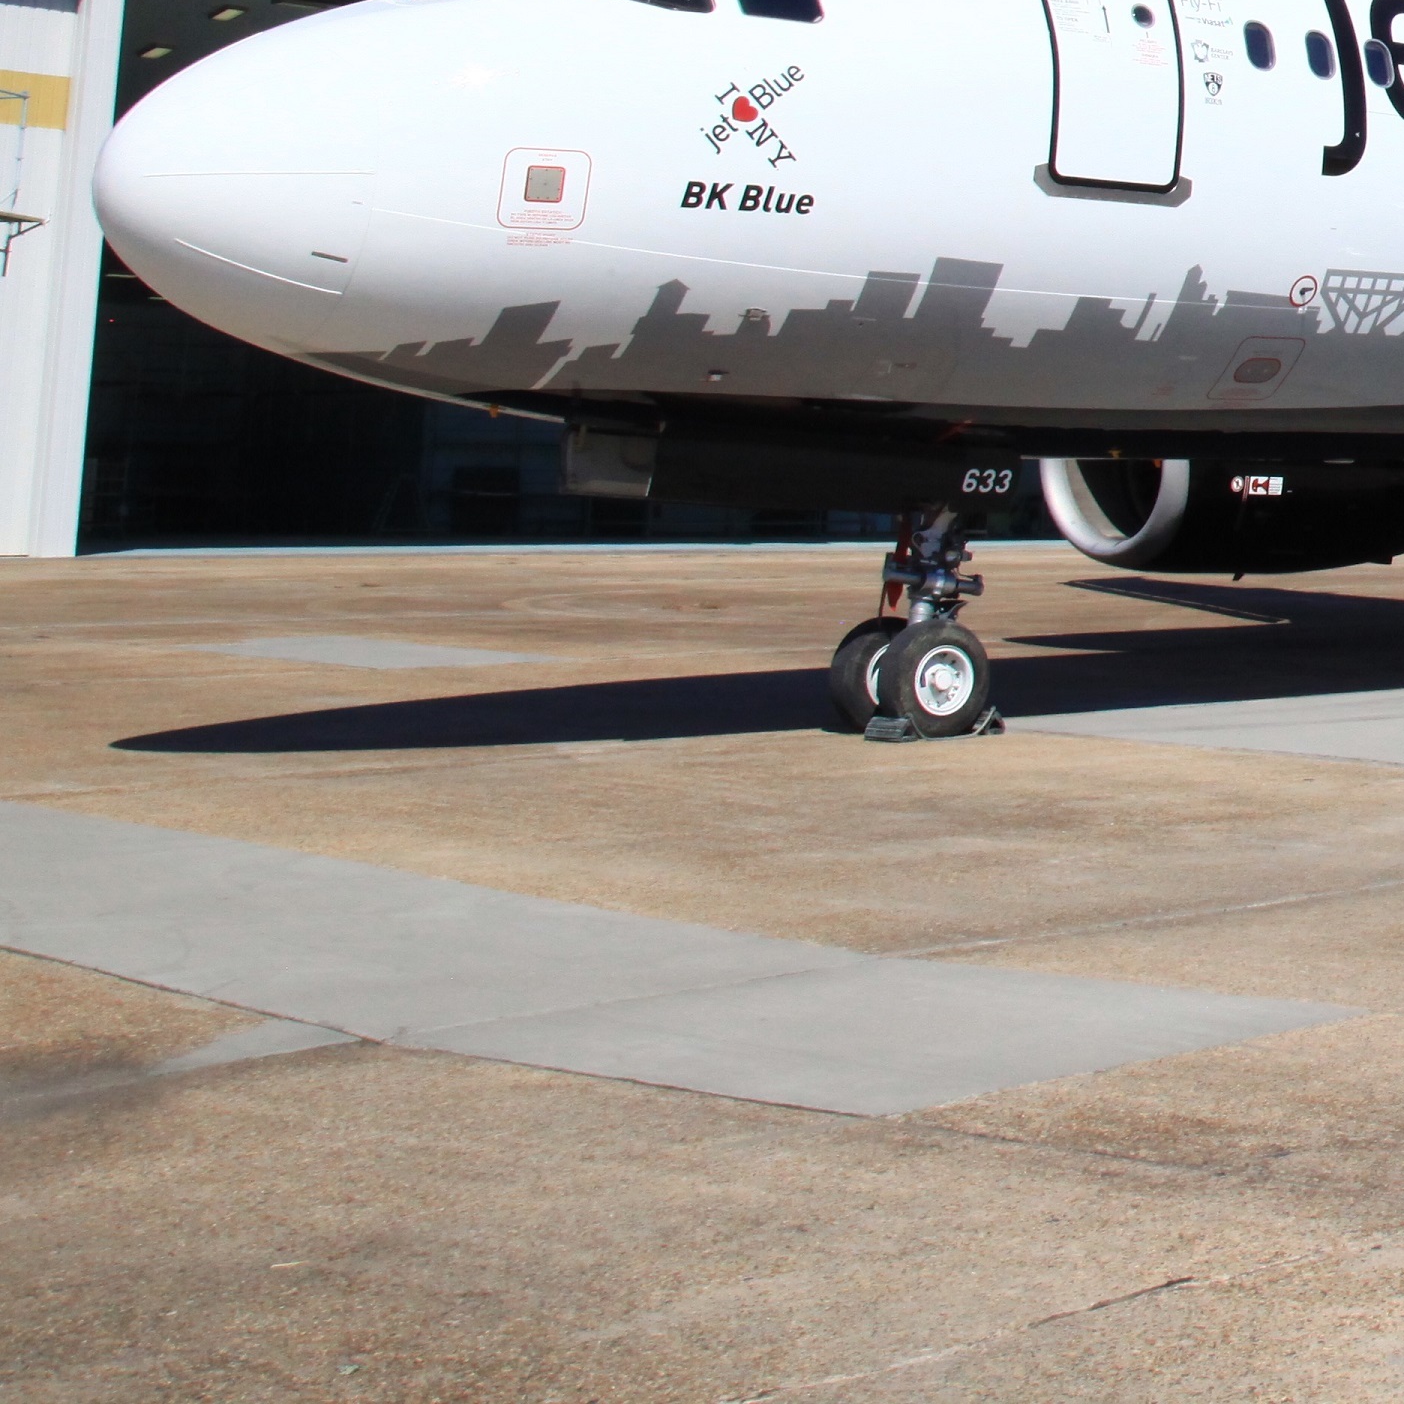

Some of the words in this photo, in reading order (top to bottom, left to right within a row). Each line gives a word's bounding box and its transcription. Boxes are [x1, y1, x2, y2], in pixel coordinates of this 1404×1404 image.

[745, 117, 798, 169] NY
[680, 180, 735, 211] BK
[738, 184, 815, 215] Blue
[962, 468, 1013, 493] 633
